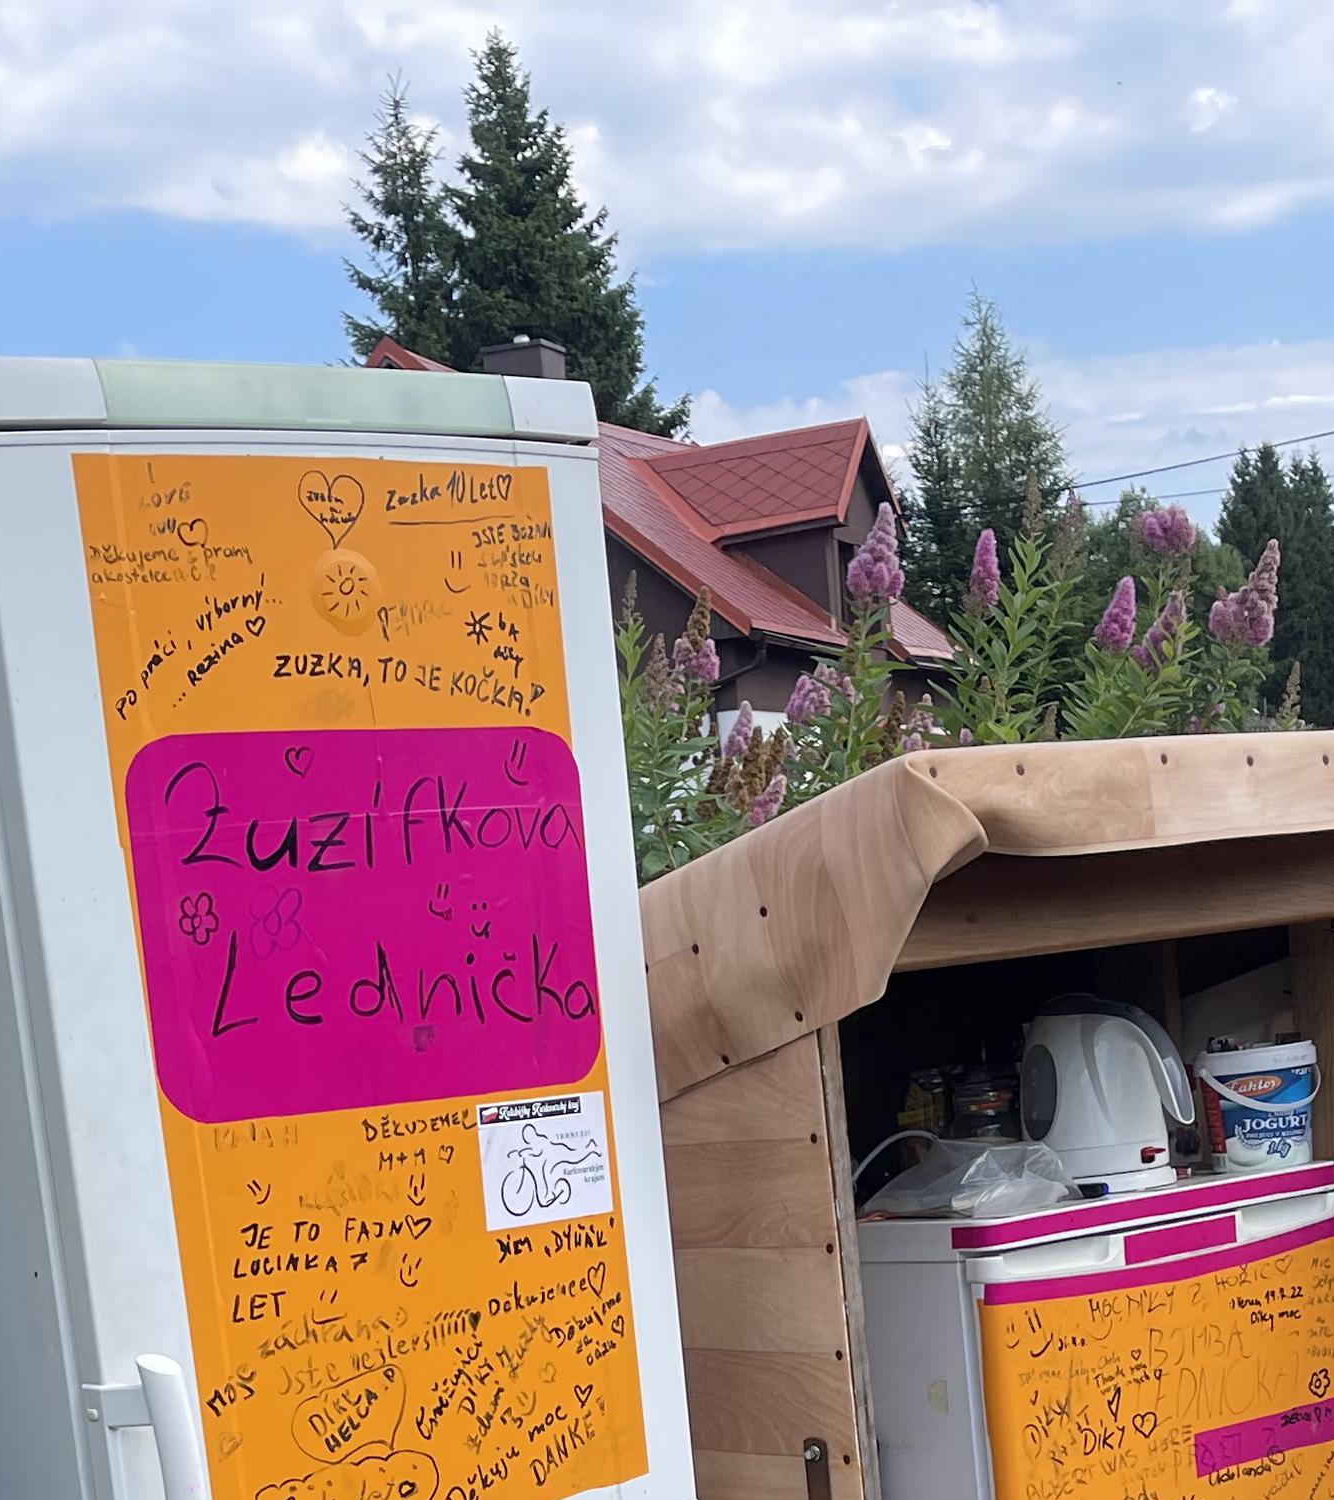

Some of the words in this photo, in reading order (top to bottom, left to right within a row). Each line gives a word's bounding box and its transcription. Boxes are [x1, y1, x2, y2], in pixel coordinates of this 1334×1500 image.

[273, 653, 370, 687] ZUZKA,
[377, 657, 407, 684] TO
[414, 665, 443, 692] JE
[1242, 1113, 1308, 1132] JOGURT
[241, 1222, 274, 1250] JE
[293, 1220, 321, 1242] TO
[345, 1217, 404, 1244] FAJN
[232, 1290, 287, 1323] LET
[528, 1404, 568, 1442] moc
